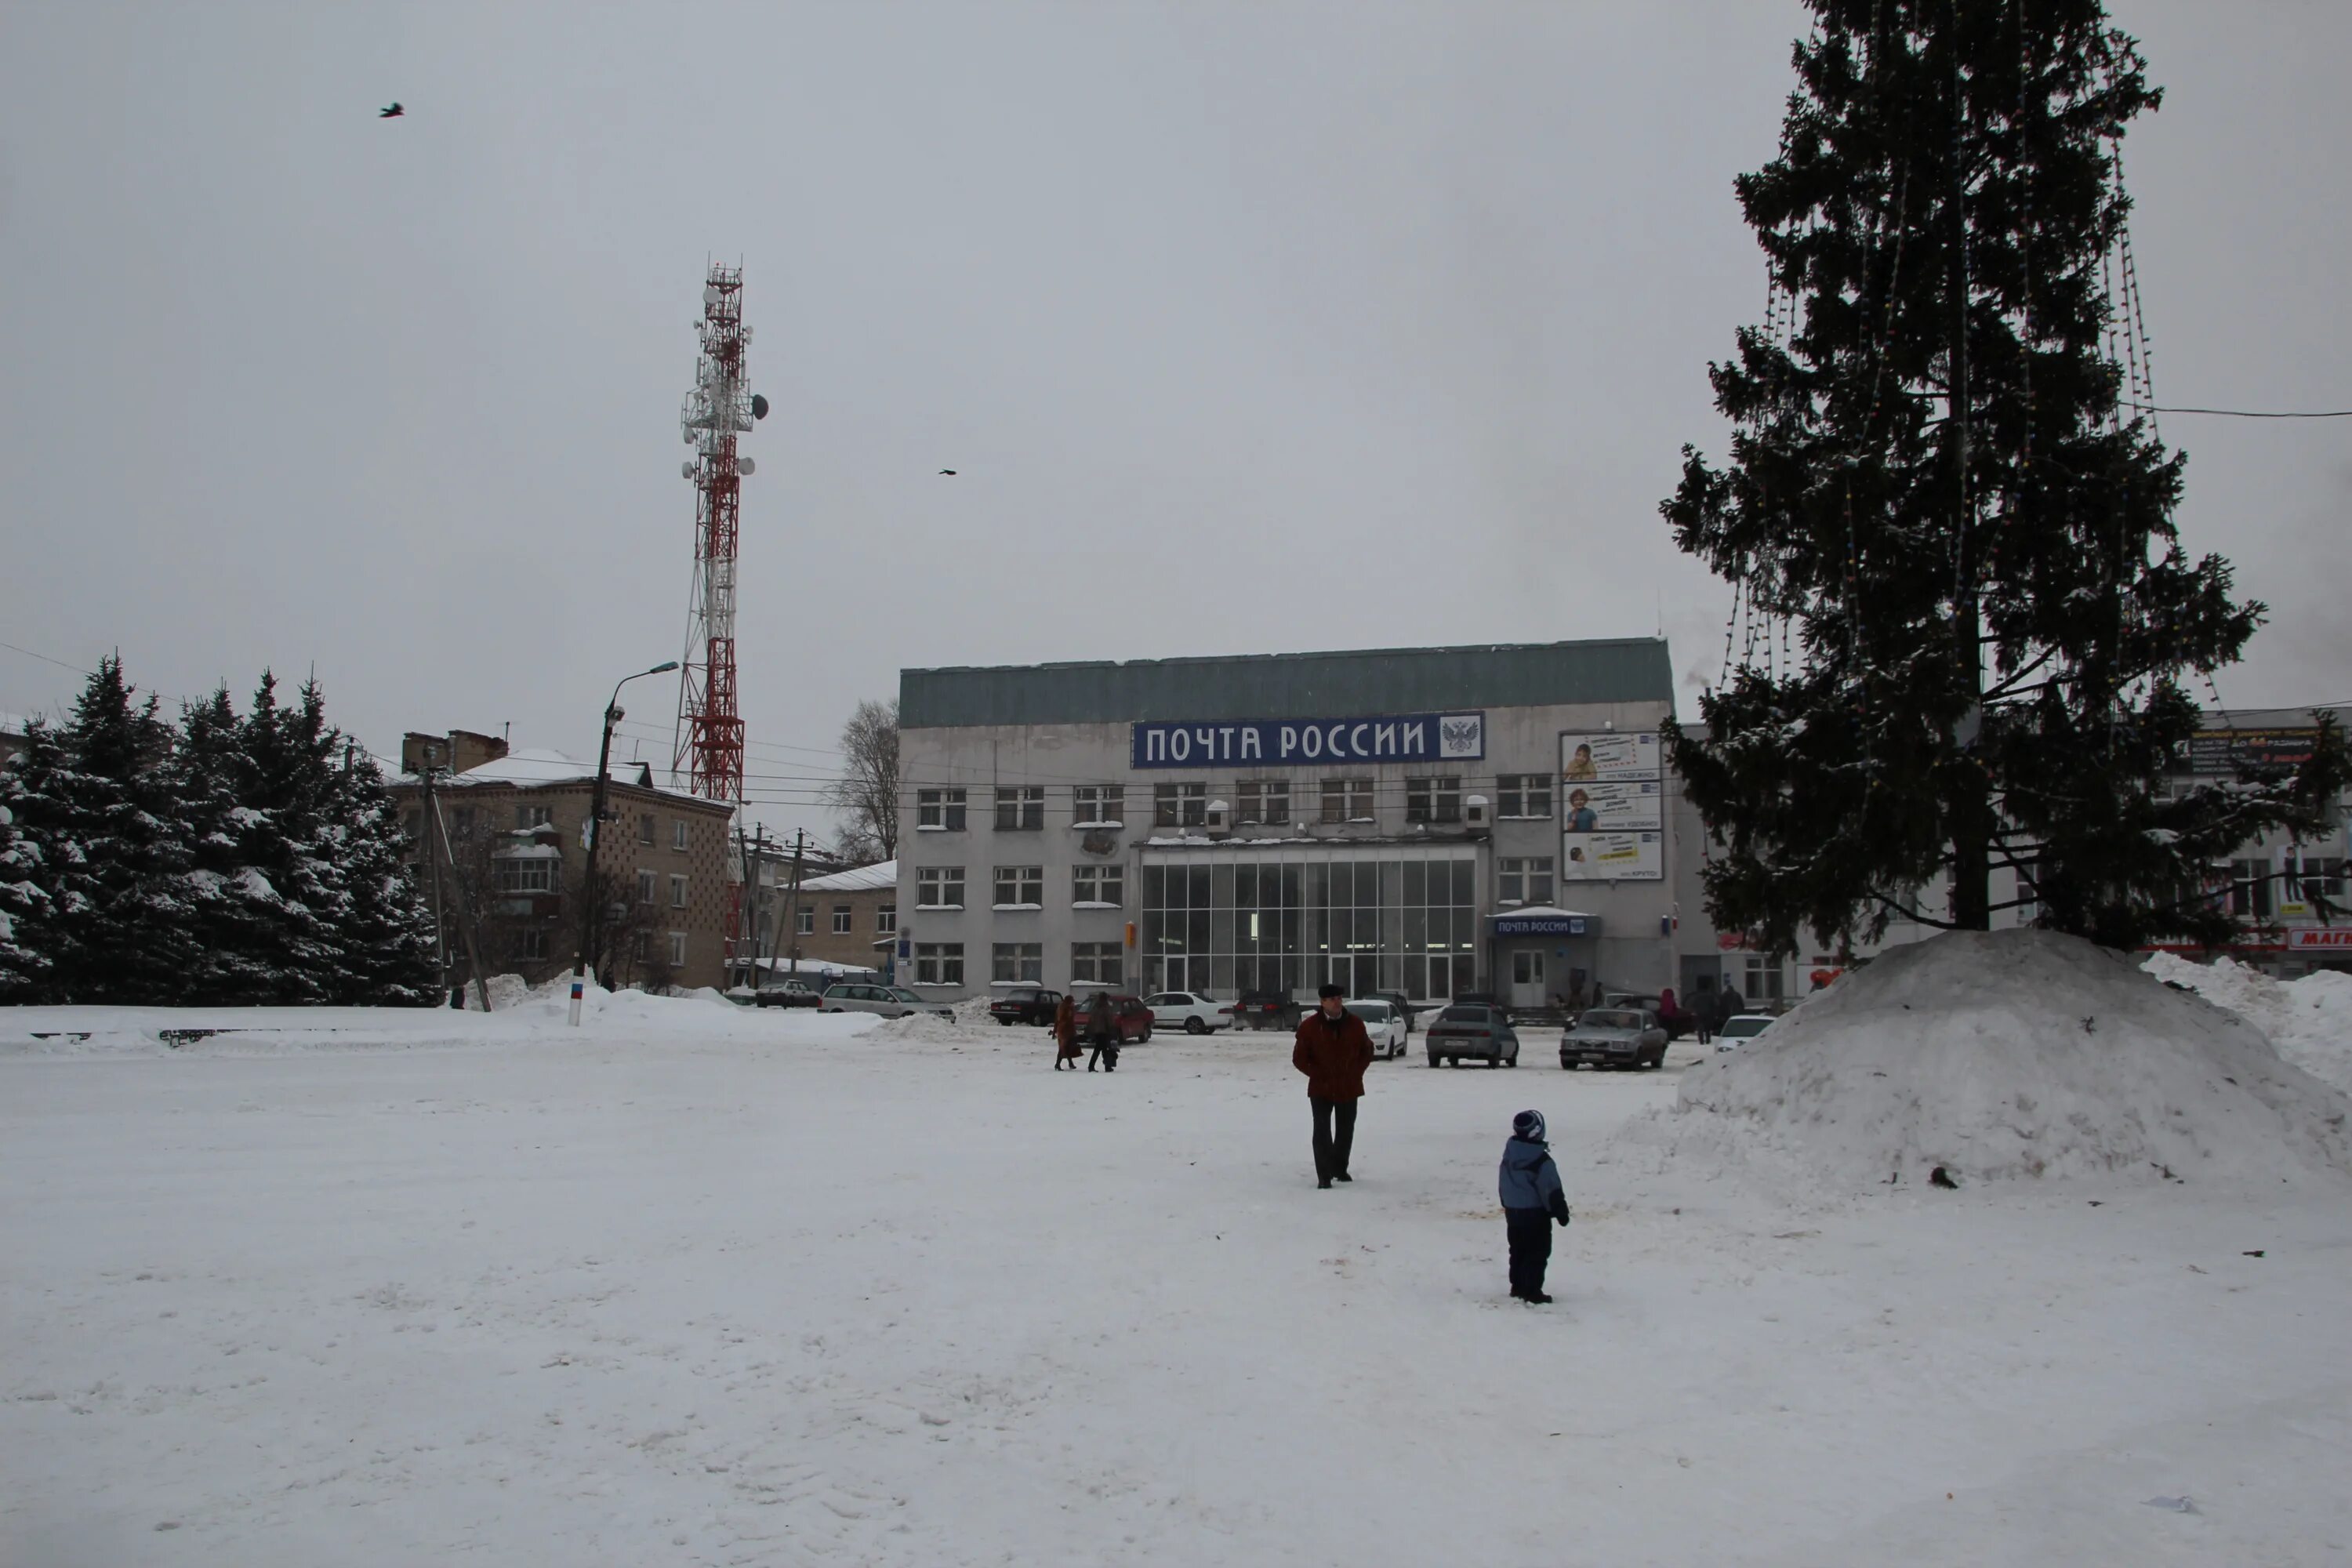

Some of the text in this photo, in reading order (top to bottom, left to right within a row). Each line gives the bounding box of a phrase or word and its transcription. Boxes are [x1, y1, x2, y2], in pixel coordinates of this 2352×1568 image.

[1147, 721, 1425, 760] ПОЧТА РОССИИ
[1498, 920, 1568, 932] ПОЧТА РОССИИ
